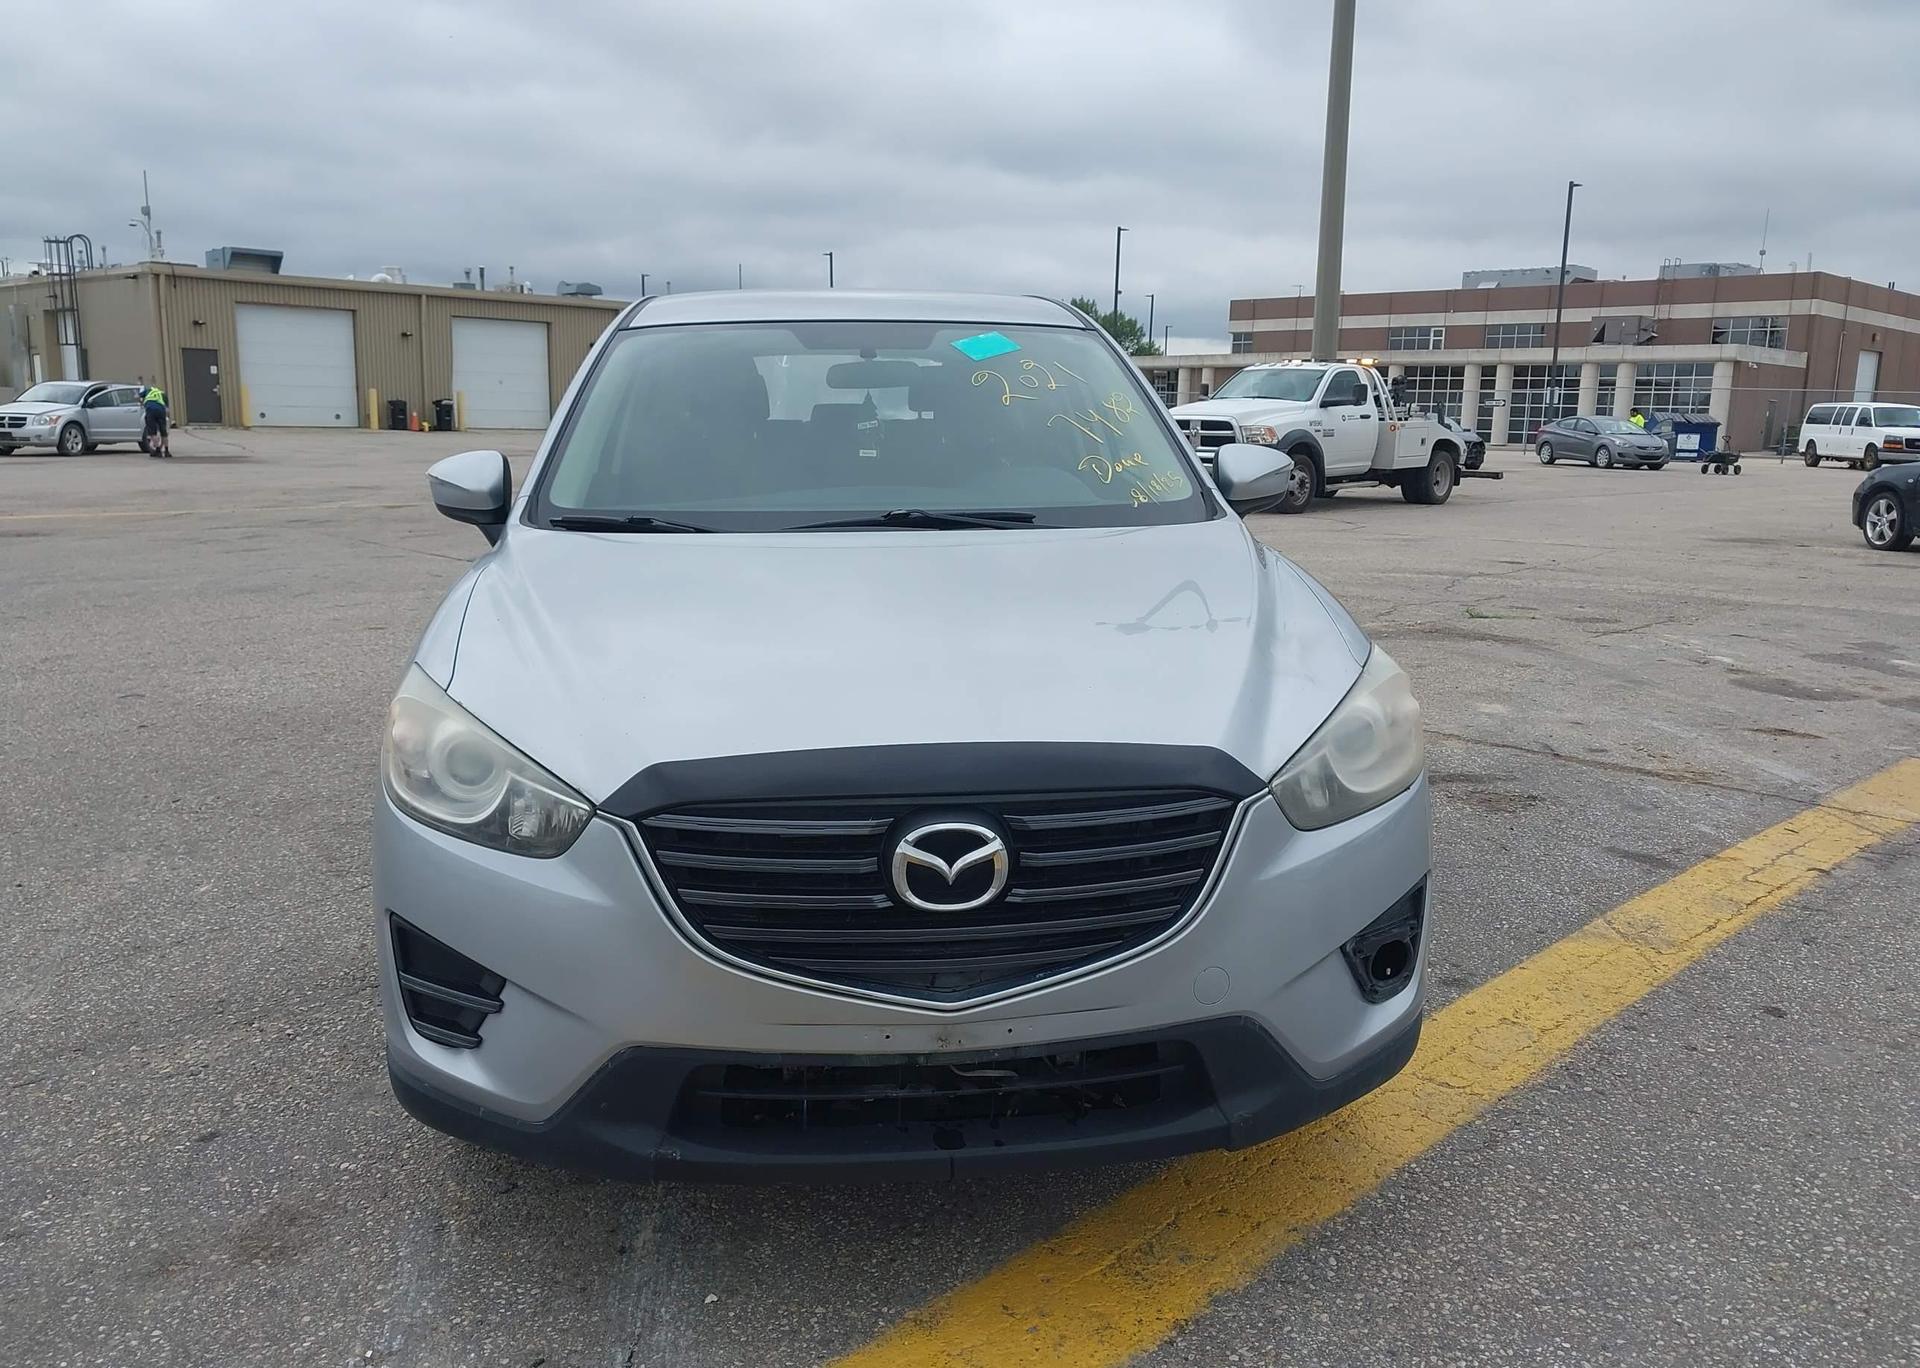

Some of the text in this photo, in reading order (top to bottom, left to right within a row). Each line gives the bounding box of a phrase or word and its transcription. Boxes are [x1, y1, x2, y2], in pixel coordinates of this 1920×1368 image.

[971, 359, 1089, 406] 2021
[1047, 391, 1143, 444] 7482
[1078, 452, 1149, 484] Done
